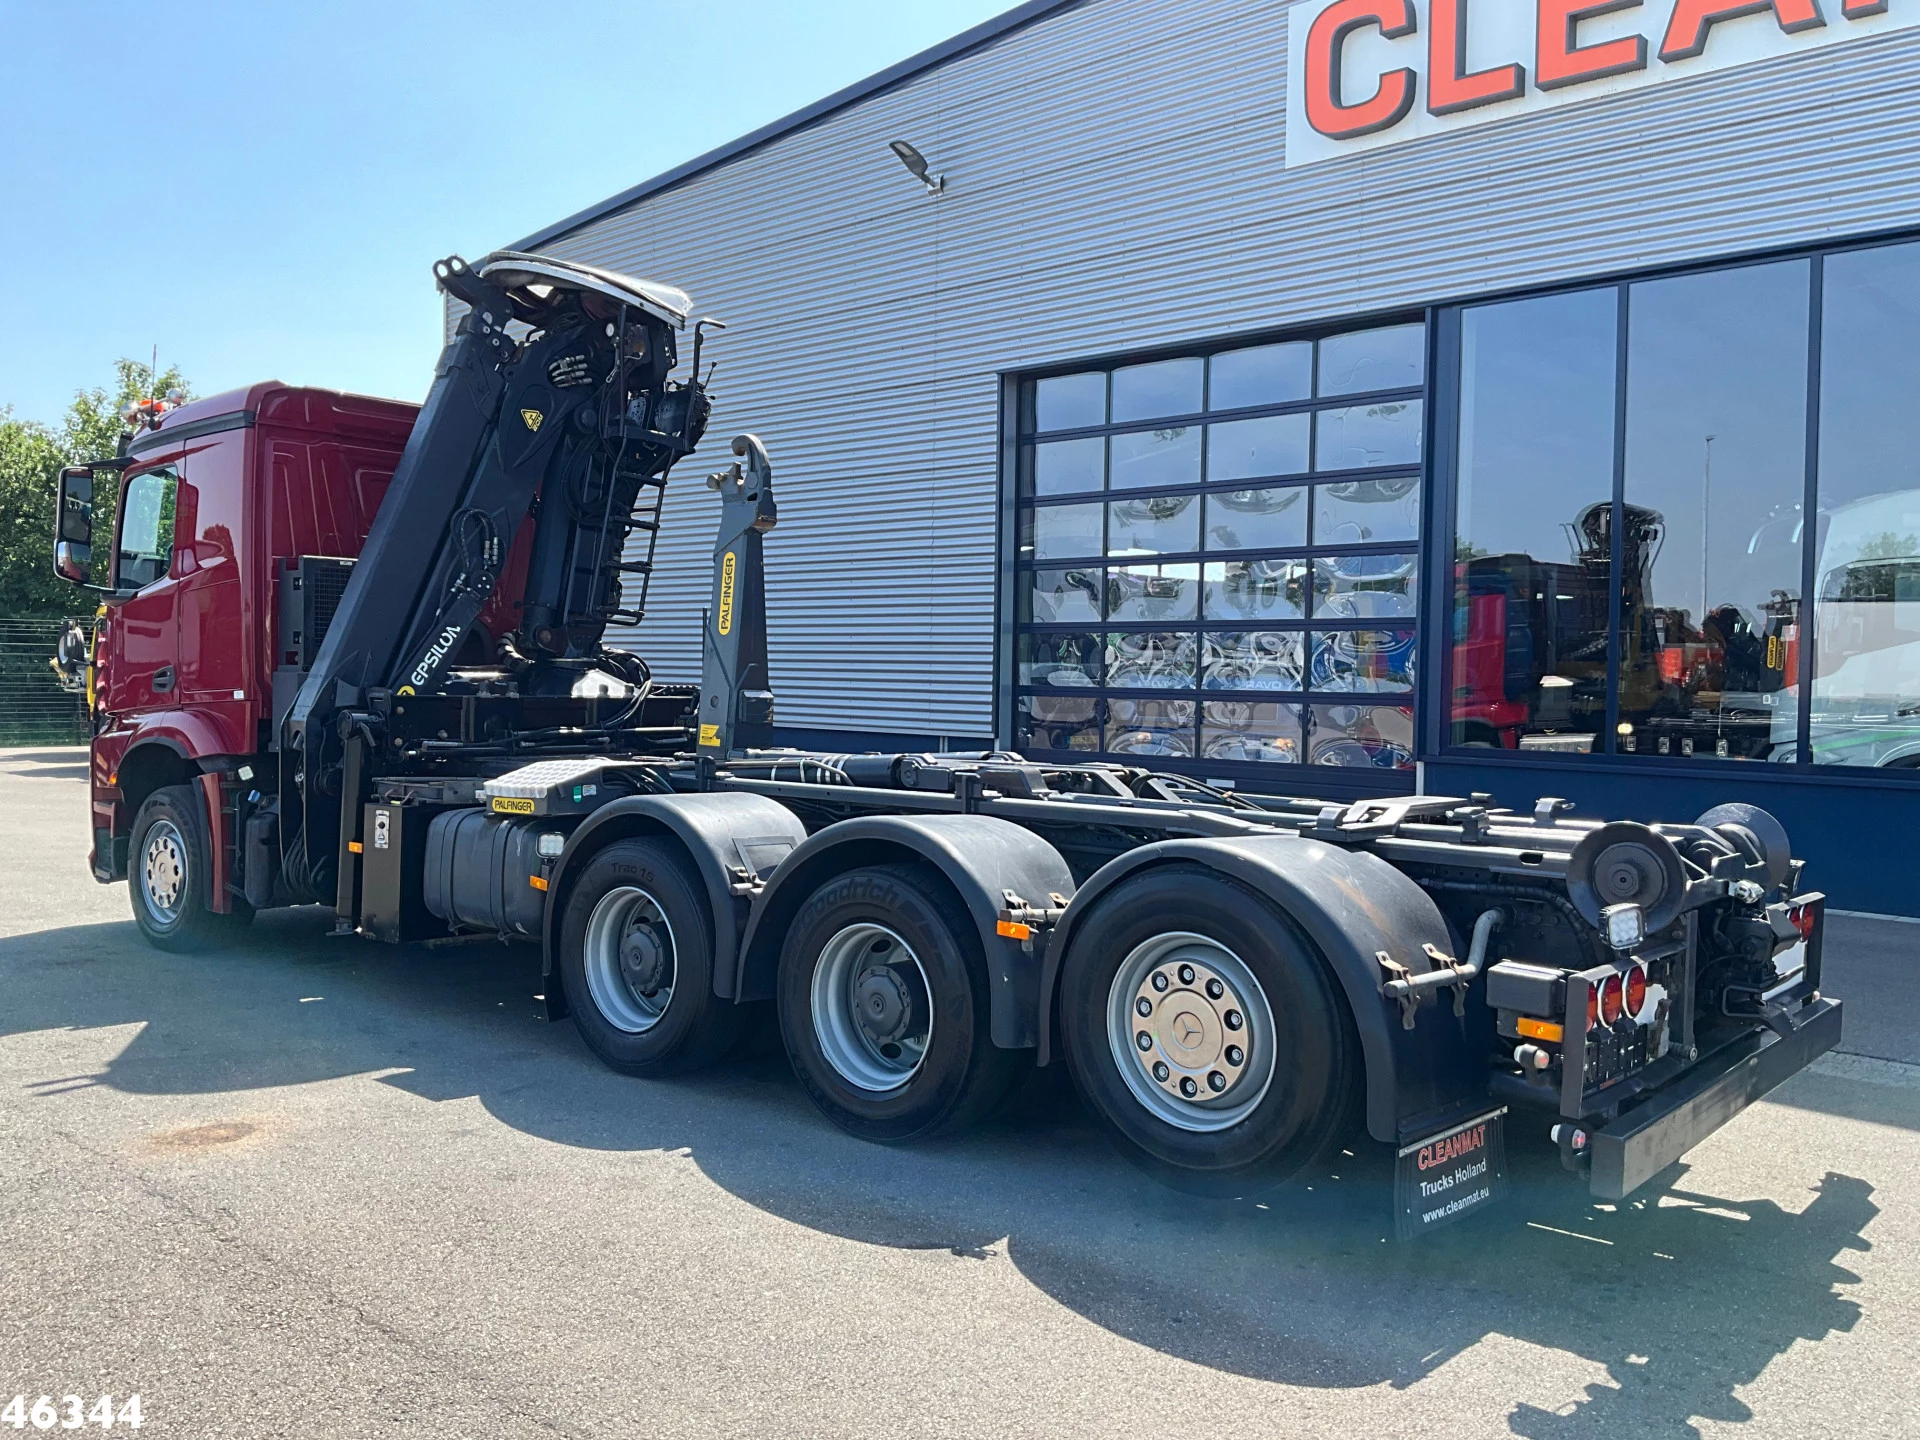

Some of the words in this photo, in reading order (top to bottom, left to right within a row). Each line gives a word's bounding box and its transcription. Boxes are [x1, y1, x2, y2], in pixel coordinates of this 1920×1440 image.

[1304, 0, 1889, 140] CLE
[720, 557, 734, 630] PALFINGER
[411, 626, 461, 686] EPSILON
[494, 799, 533, 812] PALFINGER
[1417, 1124, 1486, 1171] CLEANMAT
[1420, 1174, 1454, 1197] Trucks
[1455, 1157, 1487, 1184] Holland
[1422, 1187, 1490, 1223] www.cleanmat.eu
